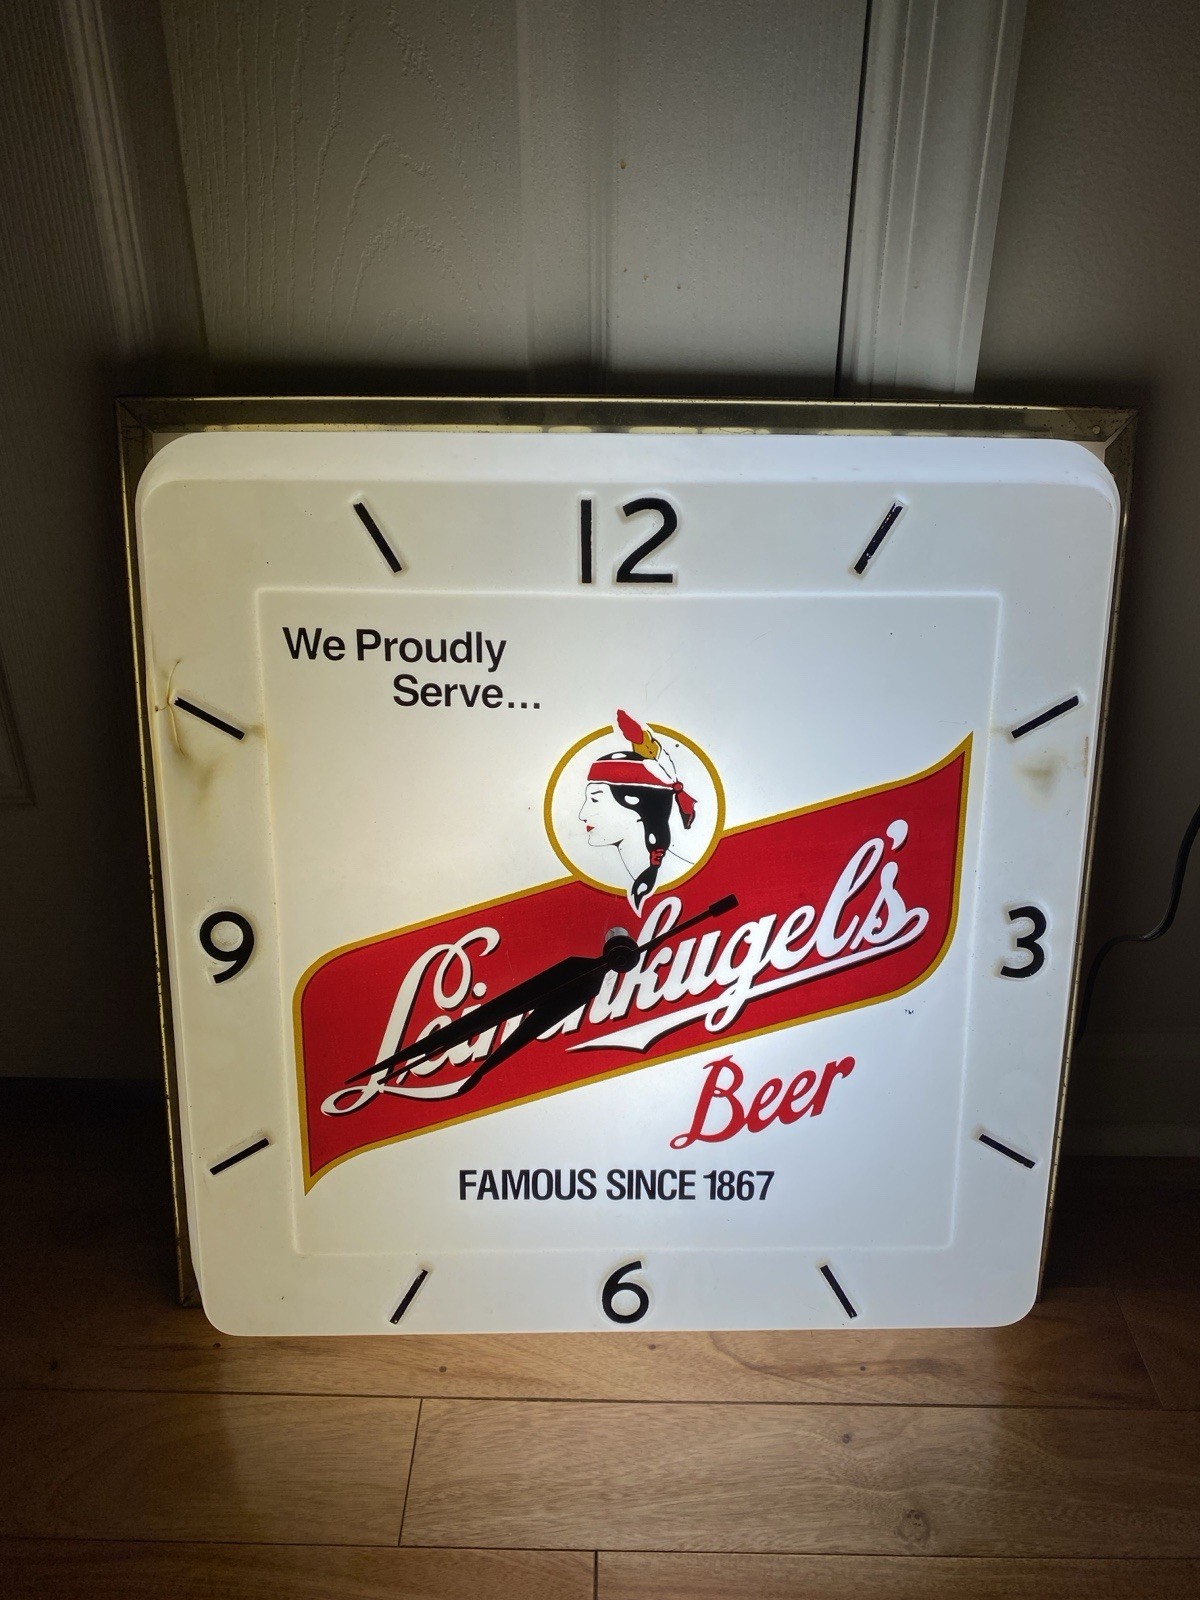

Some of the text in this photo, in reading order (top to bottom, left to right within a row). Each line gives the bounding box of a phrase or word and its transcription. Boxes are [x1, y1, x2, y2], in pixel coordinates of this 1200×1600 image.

[580, 497, 678, 584] 12
[282, 627, 507, 673] We Proudly
[393, 674, 540, 709] Serve...
[199, 910, 255, 984] 9
[1000, 905, 1047, 979] 3
[669, 1055, 855, 1150] Beer
[459, 1169, 775, 1201] FAMOUS SINCE 1867
[601, 1260, 650, 1324] 6
